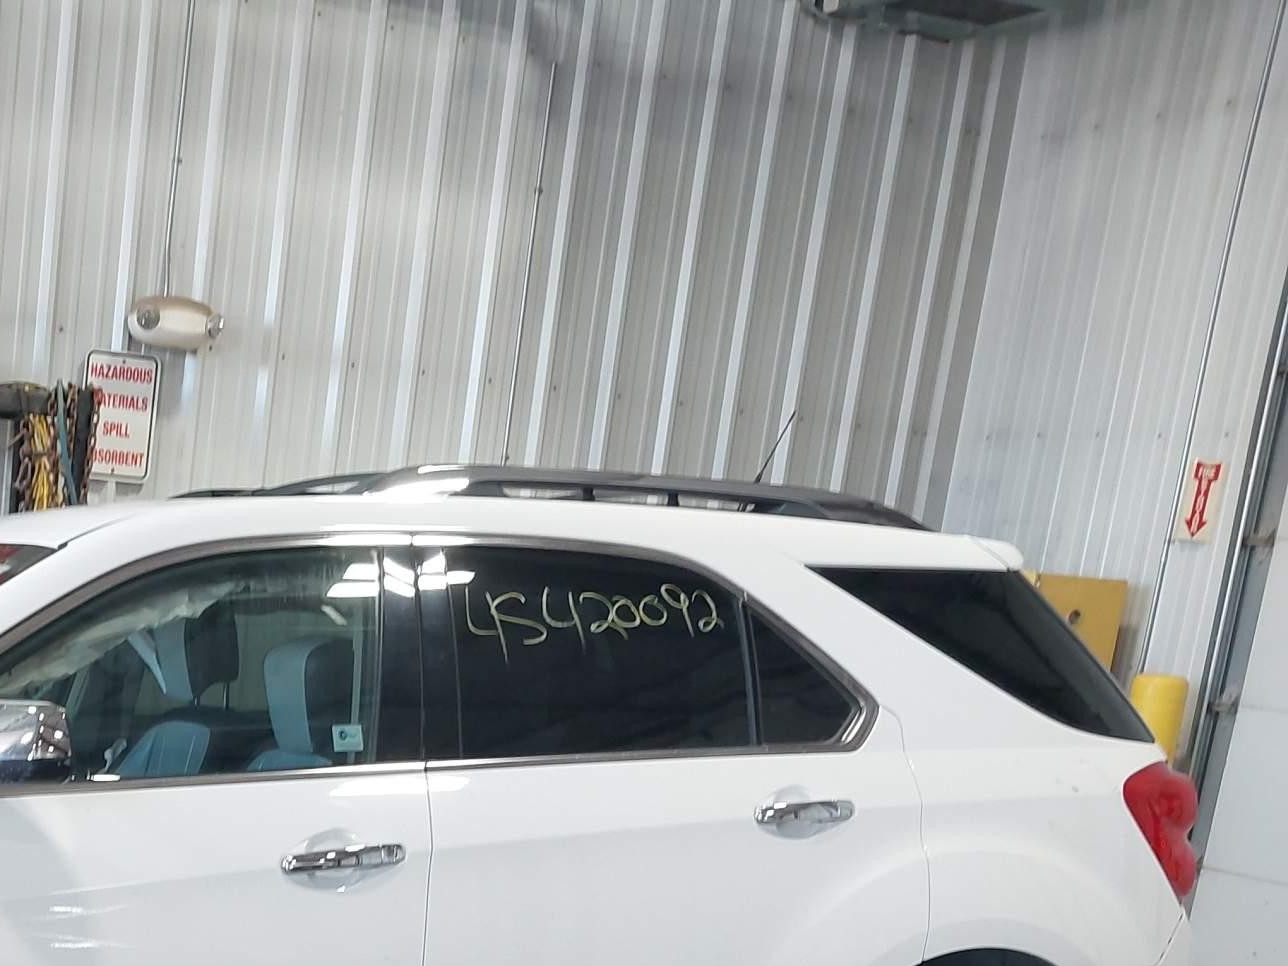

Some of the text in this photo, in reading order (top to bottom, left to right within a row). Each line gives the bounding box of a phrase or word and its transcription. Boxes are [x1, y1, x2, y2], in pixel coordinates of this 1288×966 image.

[90, 362, 153, 386] HAZARDOUS
[102, 421, 130, 439] SPILL
[466, 583, 724, 665] 45420092
